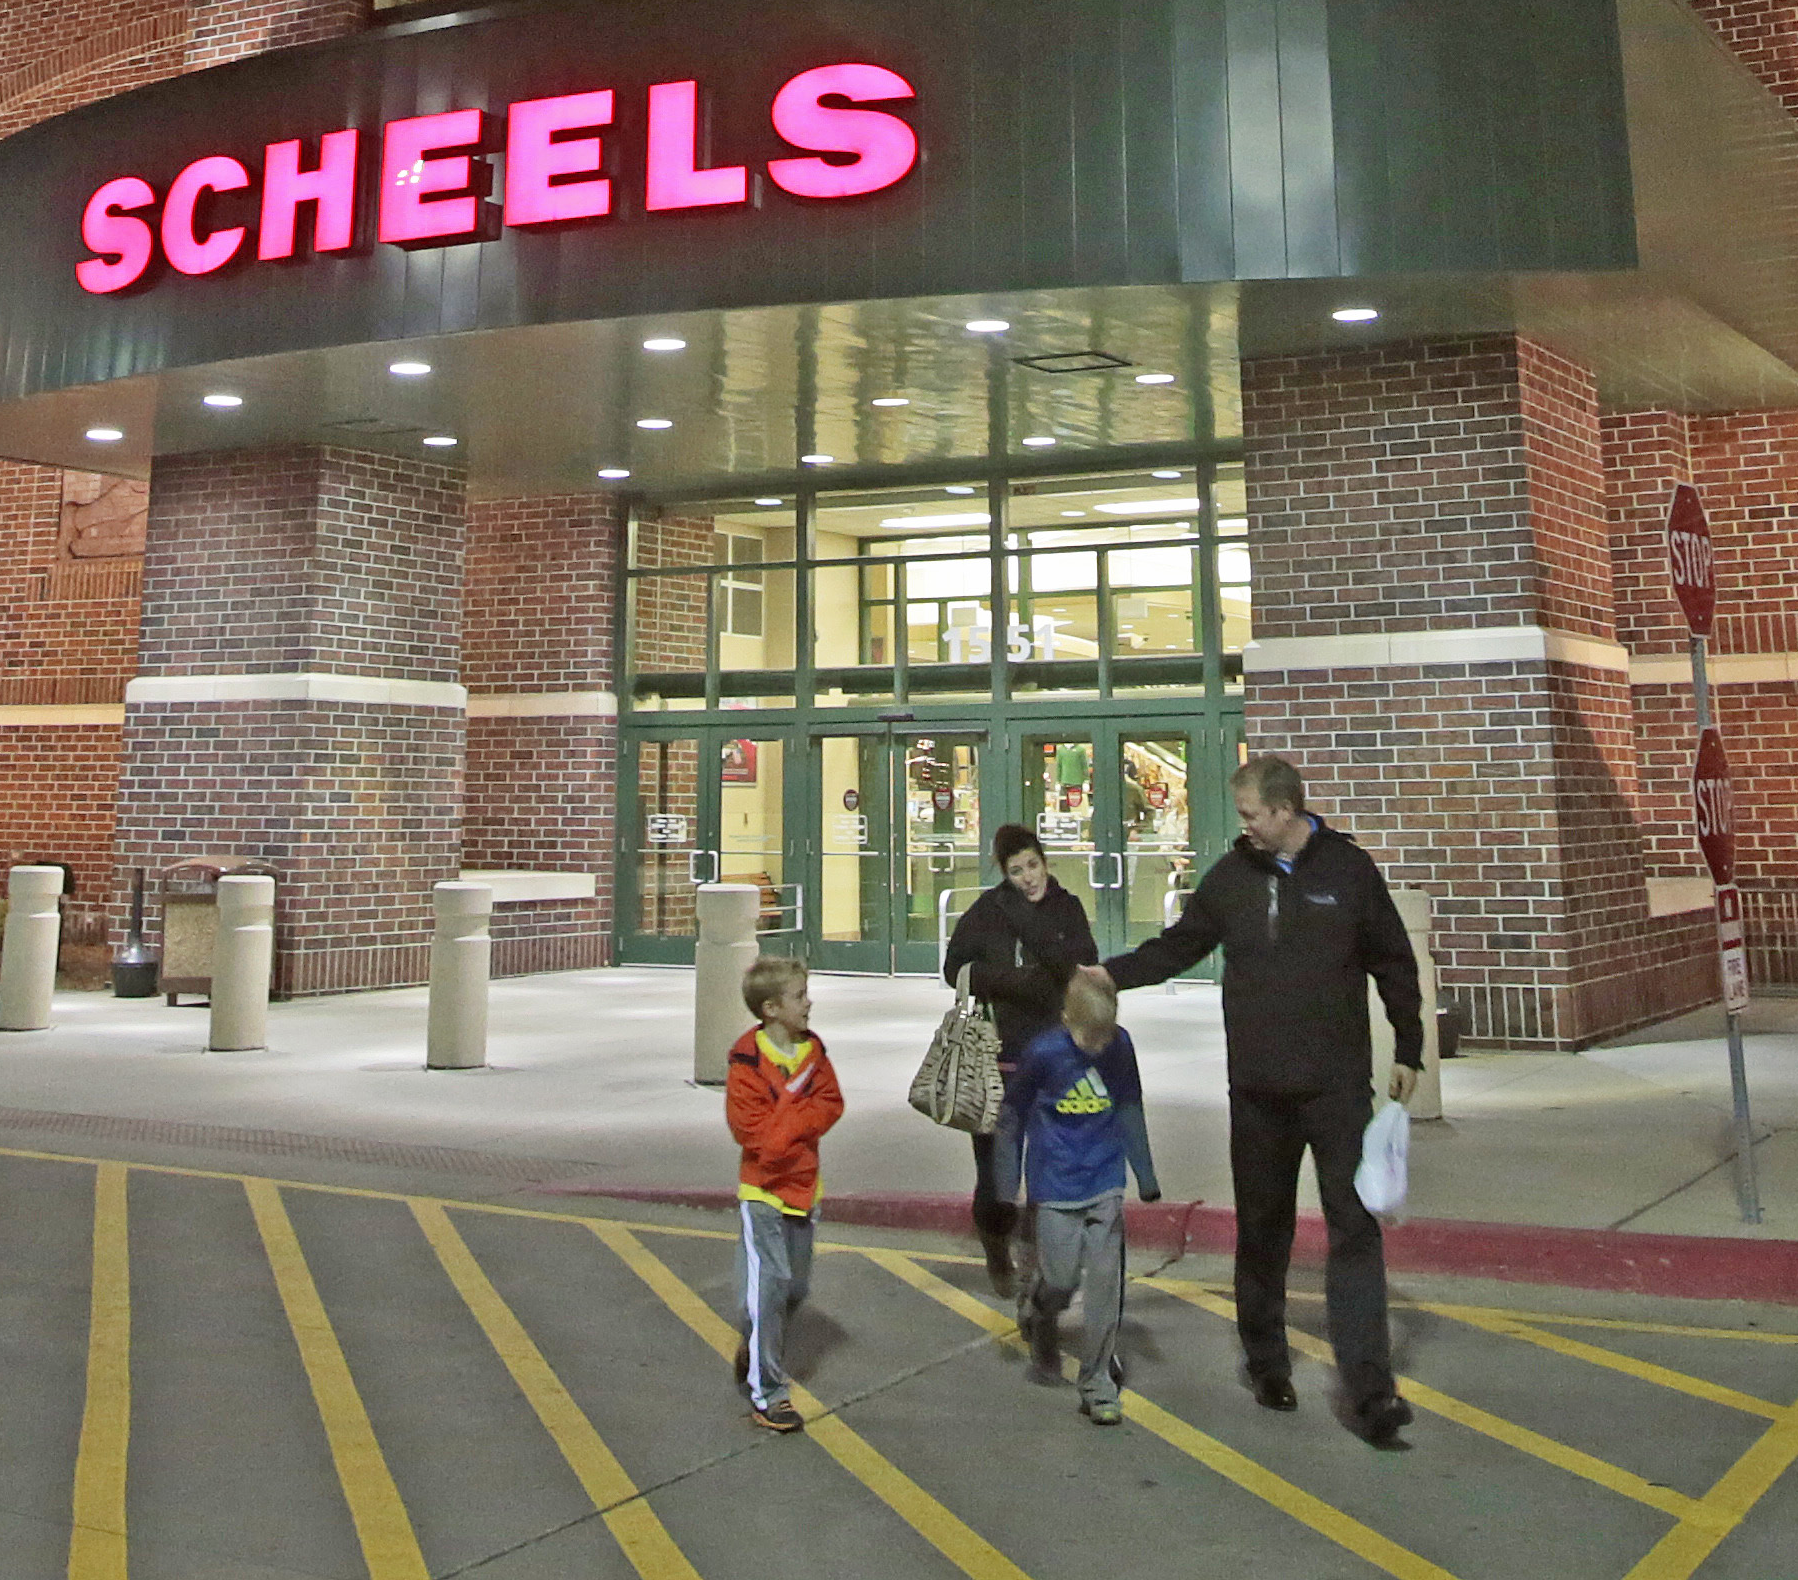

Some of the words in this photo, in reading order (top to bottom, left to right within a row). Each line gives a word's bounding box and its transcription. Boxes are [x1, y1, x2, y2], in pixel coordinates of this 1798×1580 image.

[75, 62, 918, 294] SCHEELS
[1670, 529, 1711, 588] STOP
[942, 623, 1056, 663] 1551
[1696, 778, 1732, 836] STOP
